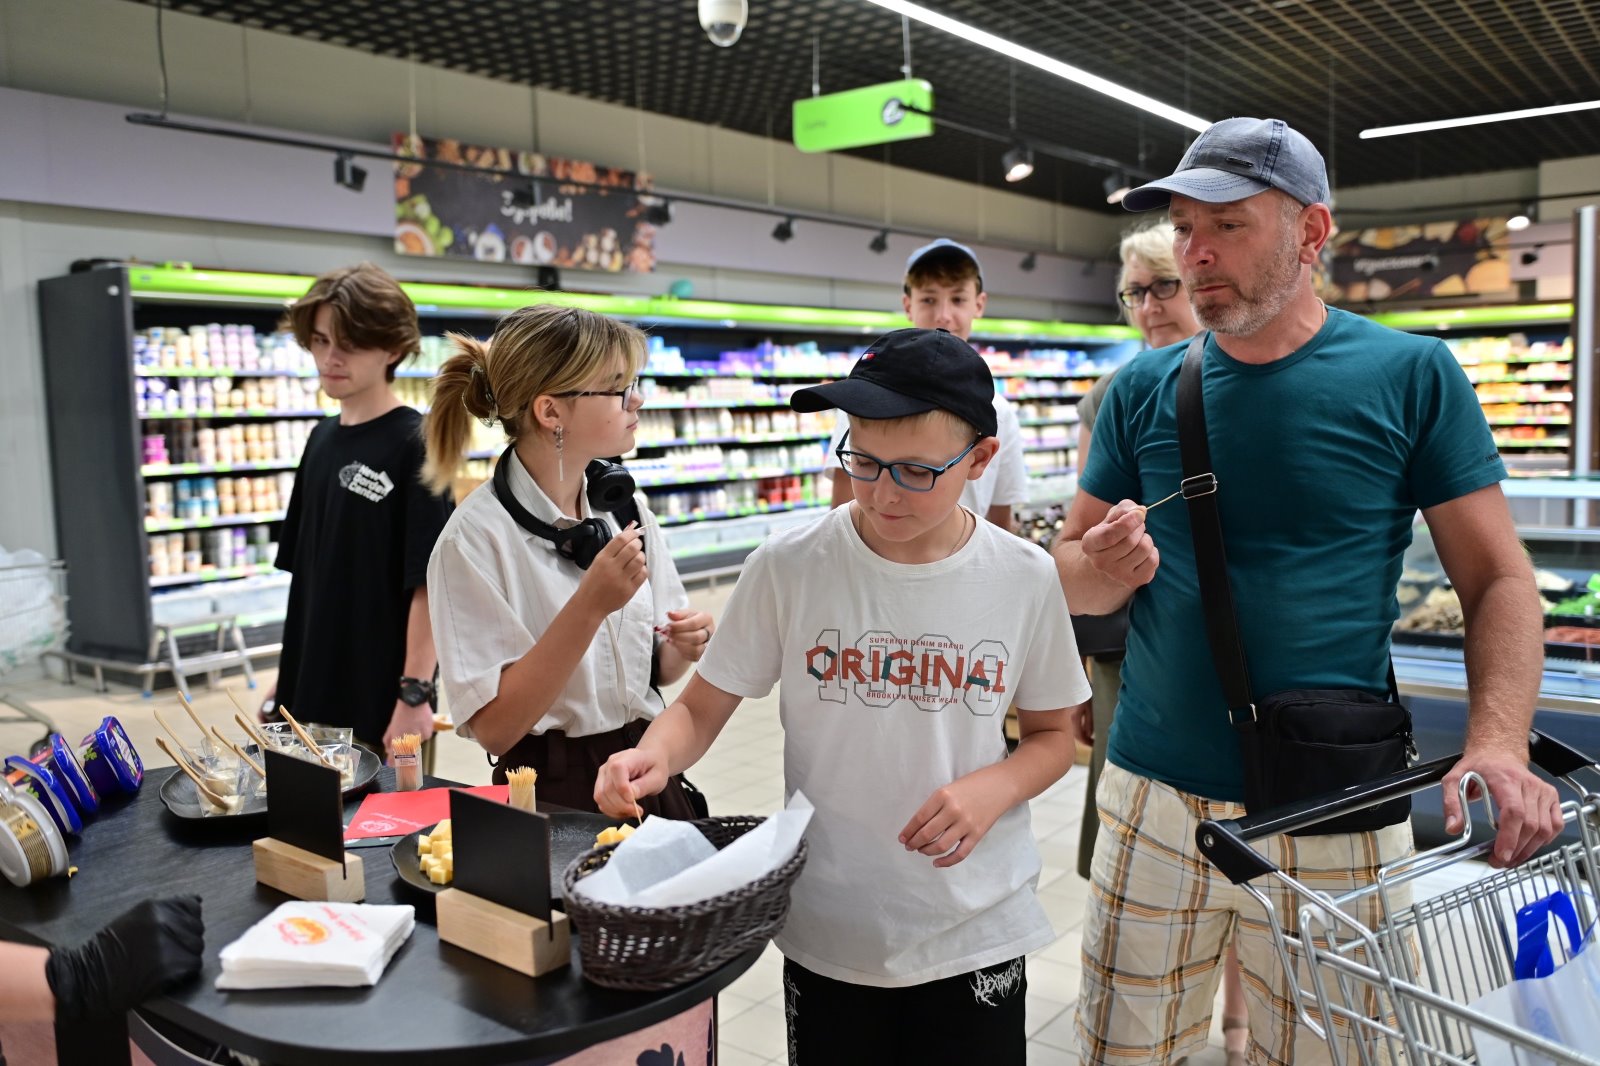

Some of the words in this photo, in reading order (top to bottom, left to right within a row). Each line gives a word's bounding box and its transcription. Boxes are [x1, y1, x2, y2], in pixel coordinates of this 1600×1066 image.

[359, 464, 381, 482] New
[348, 481, 384, 502] Center
[869, 636, 909, 646] SUPERIOR
[910, 637, 936, 648] DENIM
[937, 641, 965, 651] BRAND
[805, 645, 1006, 694] ORIGINAL
[866, 691, 908, 701] BROOKLYN
[909, 694, 937, 704] UNISEX
[938, 696, 958, 705] WEAR
